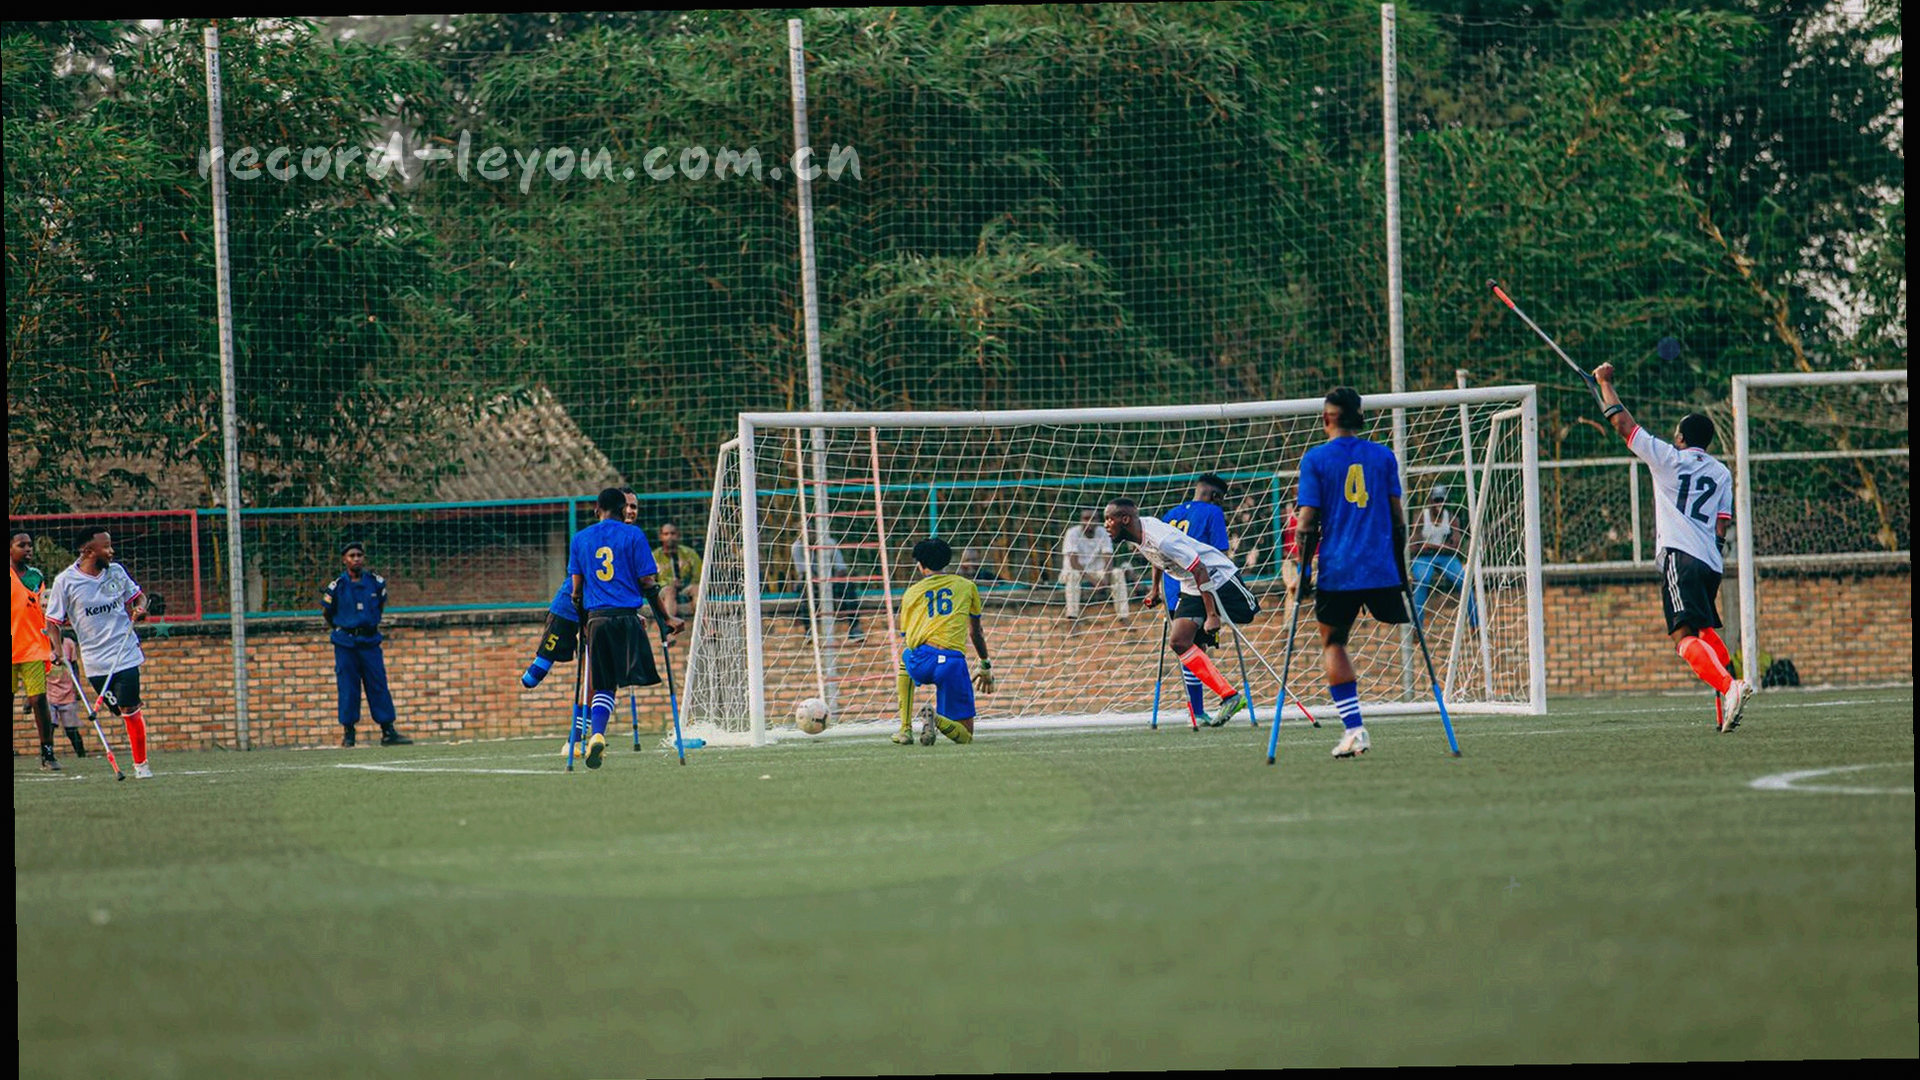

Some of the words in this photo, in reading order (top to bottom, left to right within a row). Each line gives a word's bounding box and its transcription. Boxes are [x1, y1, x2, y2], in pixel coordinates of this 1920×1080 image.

[1344, 463, 1369, 508] 4
[1676, 473, 1718, 524] 12
[595, 546, 614, 582] 3
[925, 587, 953, 618] 16
[544, 634, 560, 651] 5
[104, 690, 117, 706] 8
